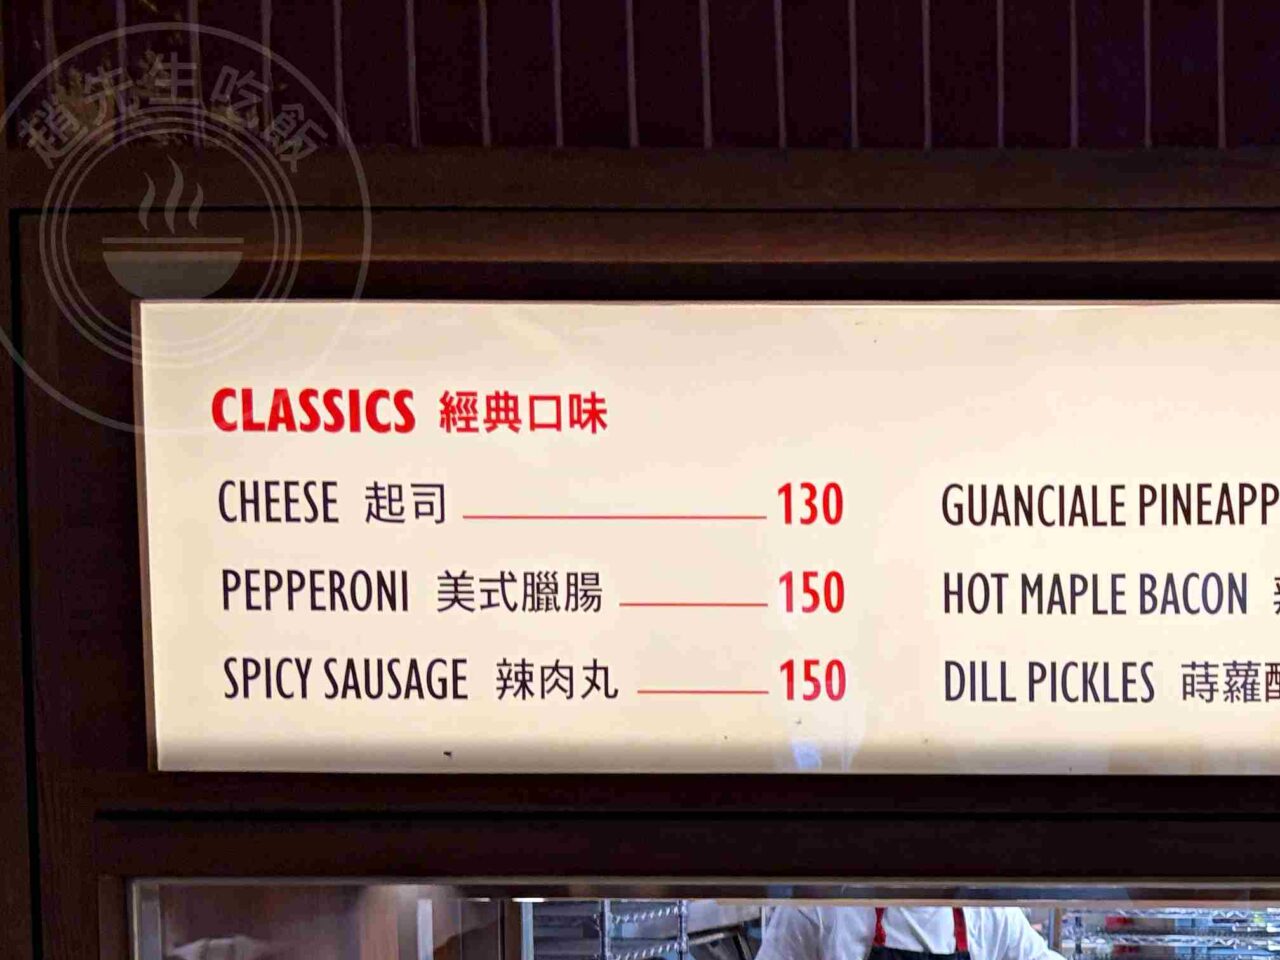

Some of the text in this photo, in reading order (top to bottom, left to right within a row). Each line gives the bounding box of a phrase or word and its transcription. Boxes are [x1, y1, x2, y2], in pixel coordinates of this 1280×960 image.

[211, 387, 608, 435] CLASSICS 經典口味
[218, 479, 844, 526] CHEESE 起司 130
[941, 483, 1127, 528] GUANCIALE
[222, 568, 845, 614] PEPPERONI 美式臘腸 150
[943, 572, 1009, 615] HOT
[1021, 573, 1127, 615] MAPLE
[1139, 572, 1247, 615] BACON
[223, 656, 847, 702] SPICY SAUSAGE 辣肉丸 150
[944, 660, 1017, 703] DILL
[1028, 661, 1155, 704] PICKLES
